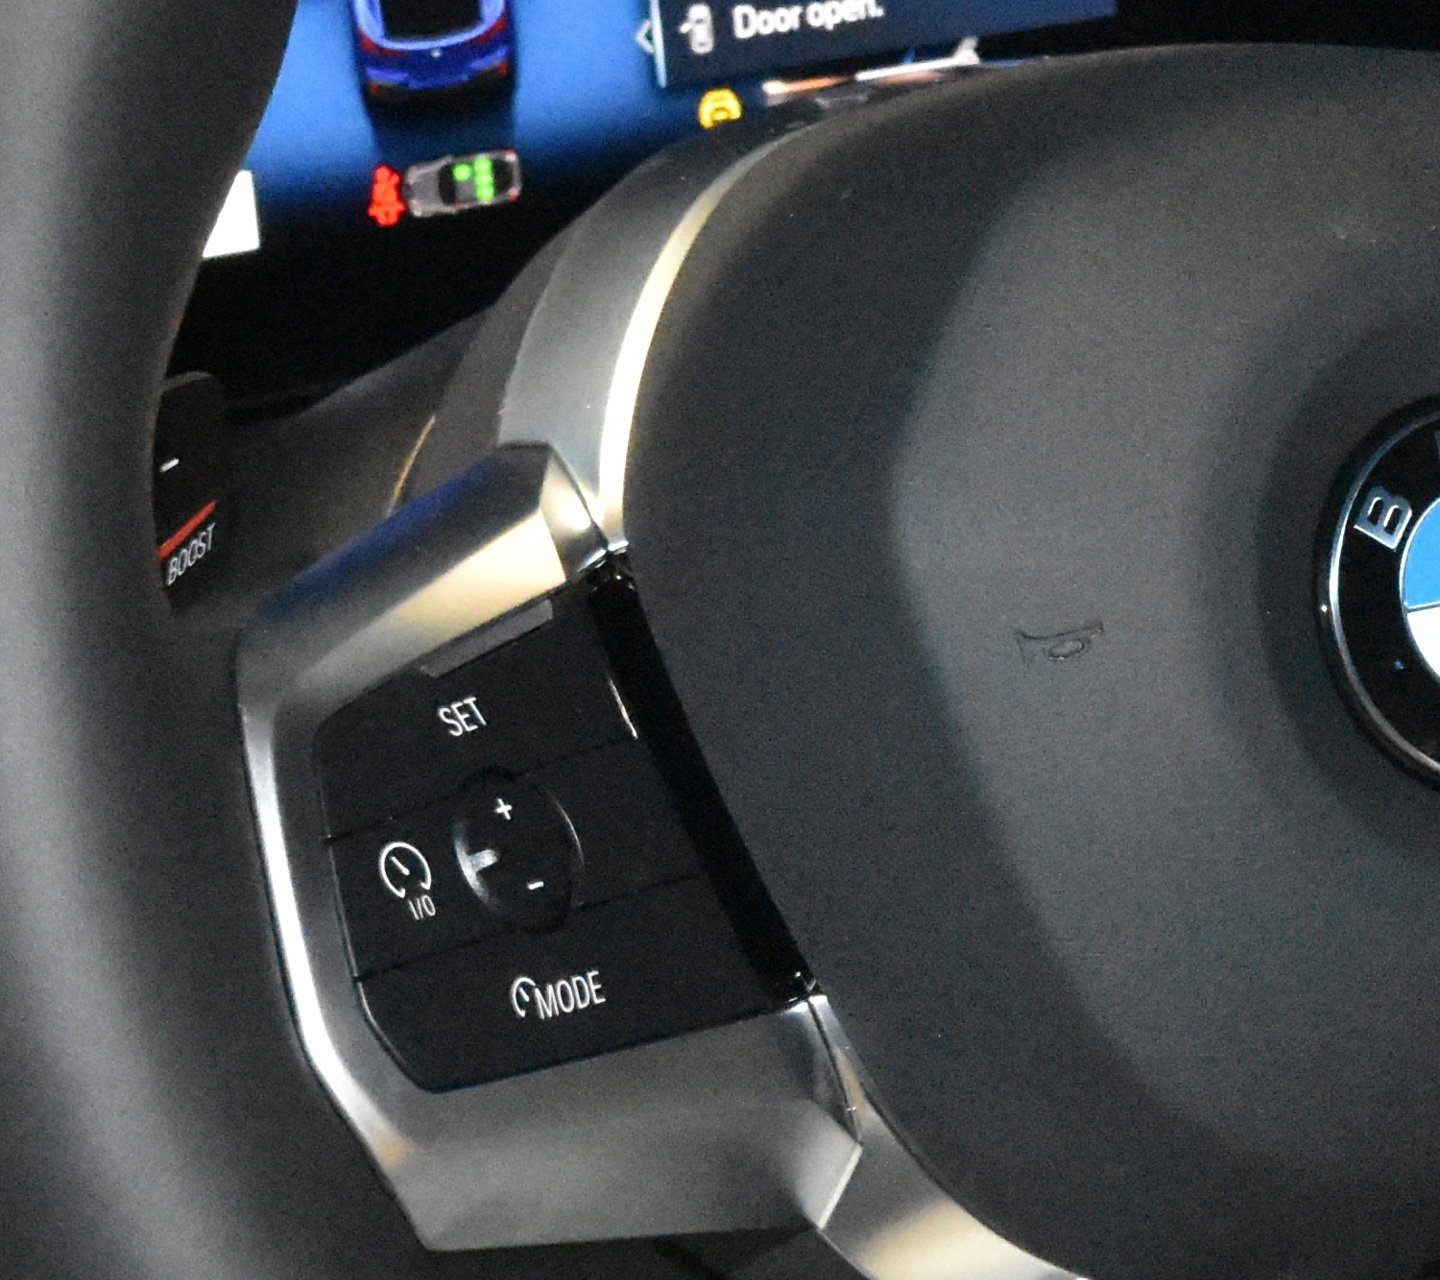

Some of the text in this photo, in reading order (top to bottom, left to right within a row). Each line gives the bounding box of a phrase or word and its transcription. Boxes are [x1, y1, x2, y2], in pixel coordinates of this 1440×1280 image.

[732, 1, 801, 40] Door
[166, 521, 217, 587] BOOST
[437, 696, 488, 737] SET
[534, 969, 607, 1020] MODE
